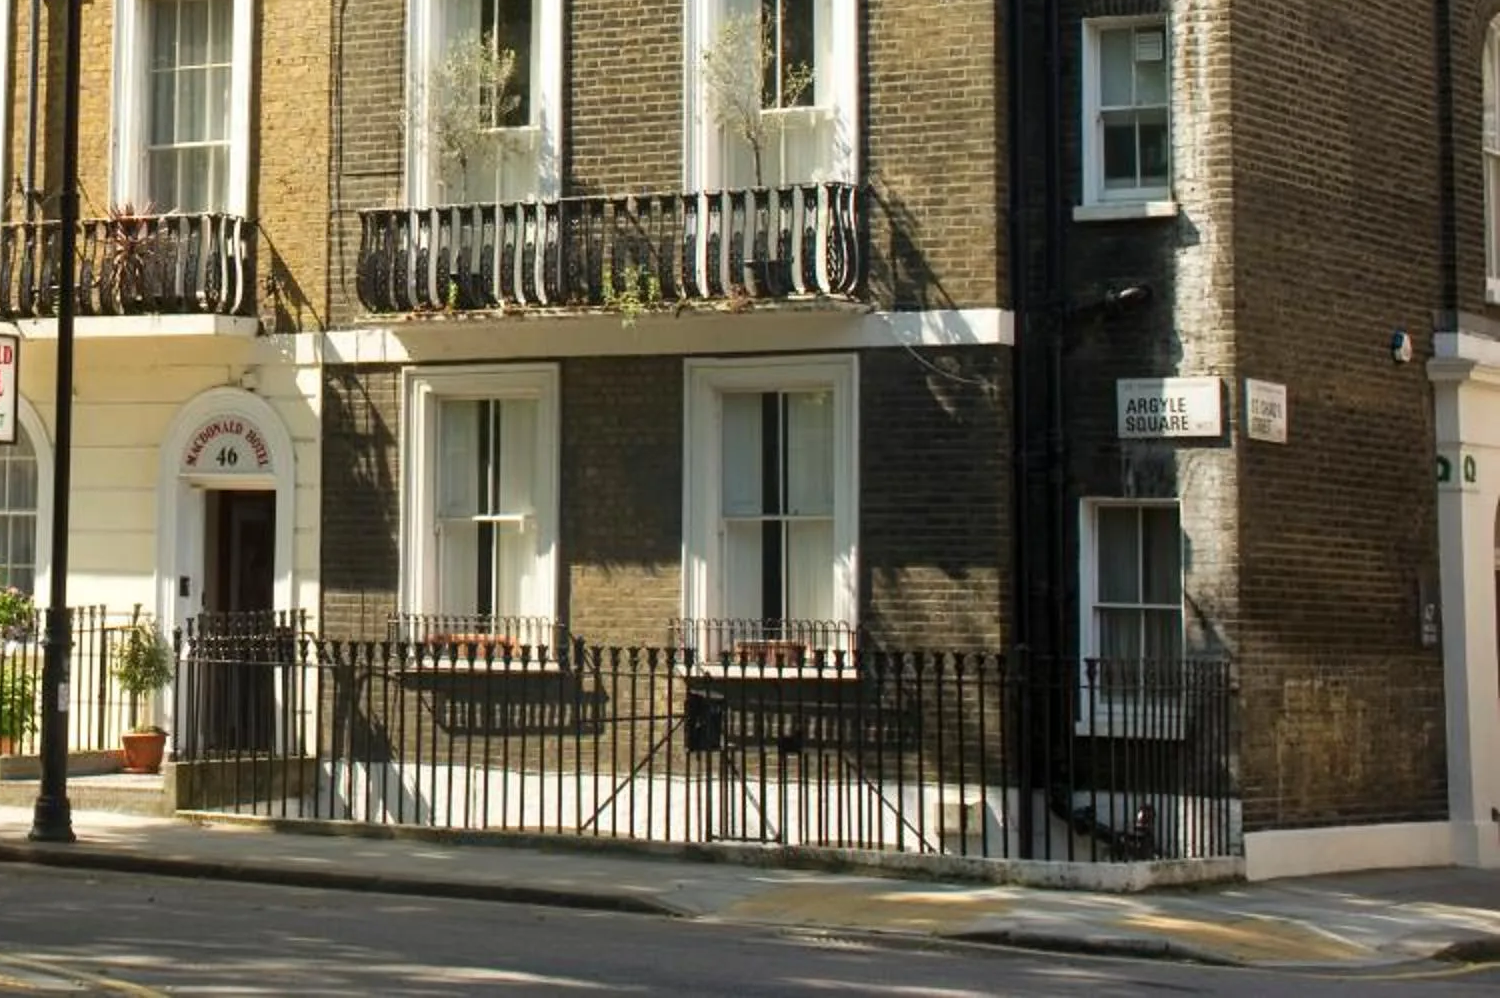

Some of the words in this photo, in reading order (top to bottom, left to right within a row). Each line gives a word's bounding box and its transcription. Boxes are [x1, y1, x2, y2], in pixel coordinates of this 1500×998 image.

[1126, 397, 1188, 414] ARGYLE
[1125, 415, 1189, 432] SQUARE
[186, 420, 244, 467] MACDONALD
[245, 429, 269, 467] HOTEL
[216, 447, 238, 467] 46
